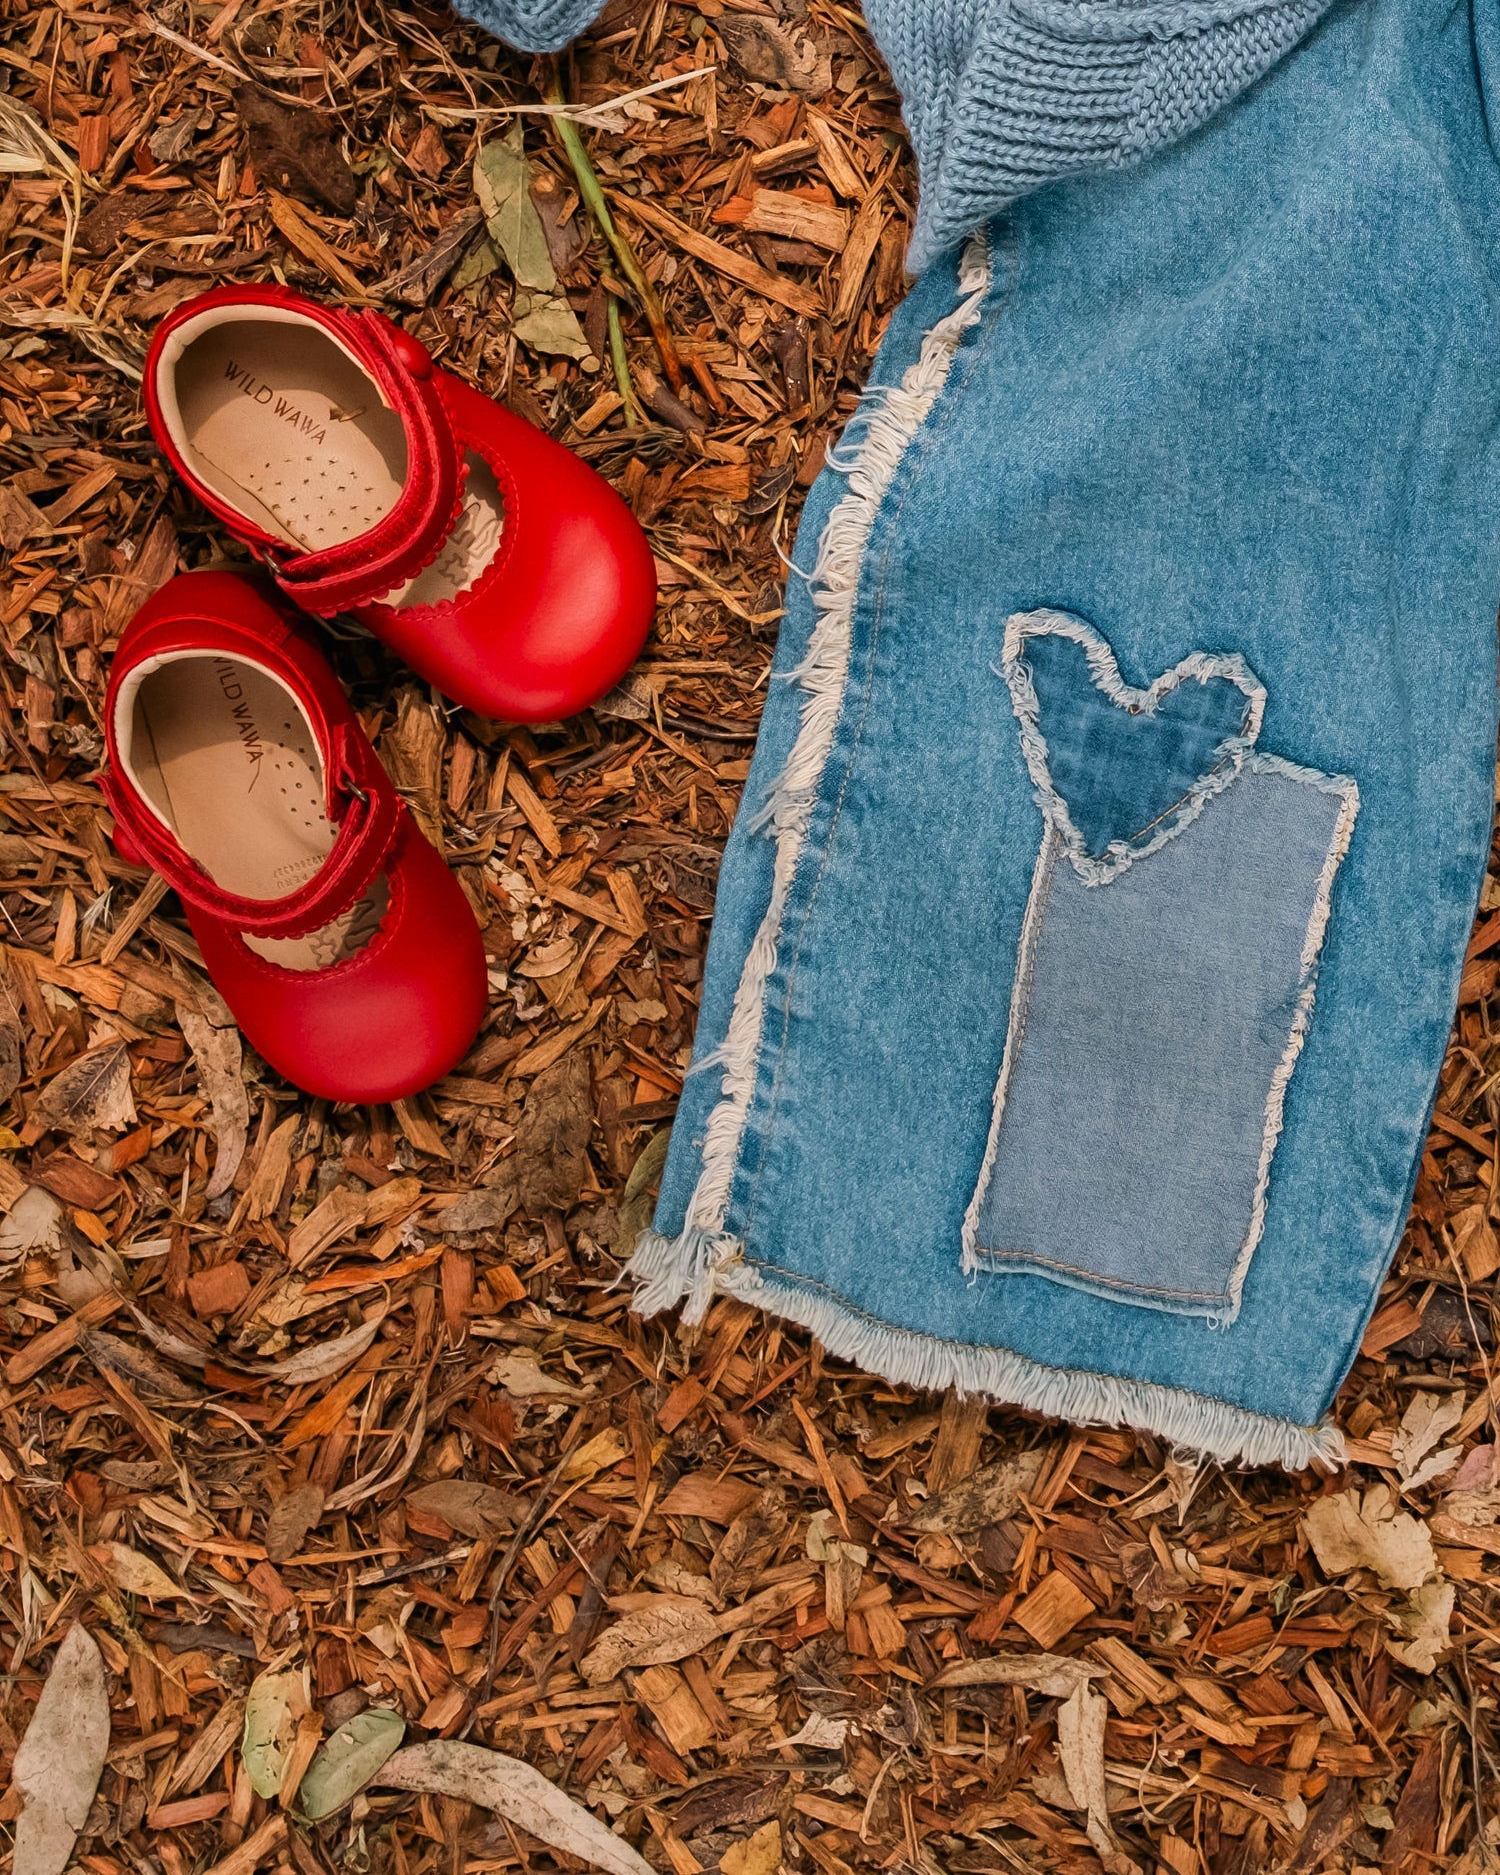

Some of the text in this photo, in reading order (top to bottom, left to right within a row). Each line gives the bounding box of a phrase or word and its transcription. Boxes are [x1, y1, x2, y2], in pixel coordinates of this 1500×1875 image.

[223, 360, 327, 446] WILD WAWA
[231, 701, 264, 764] WAWA
